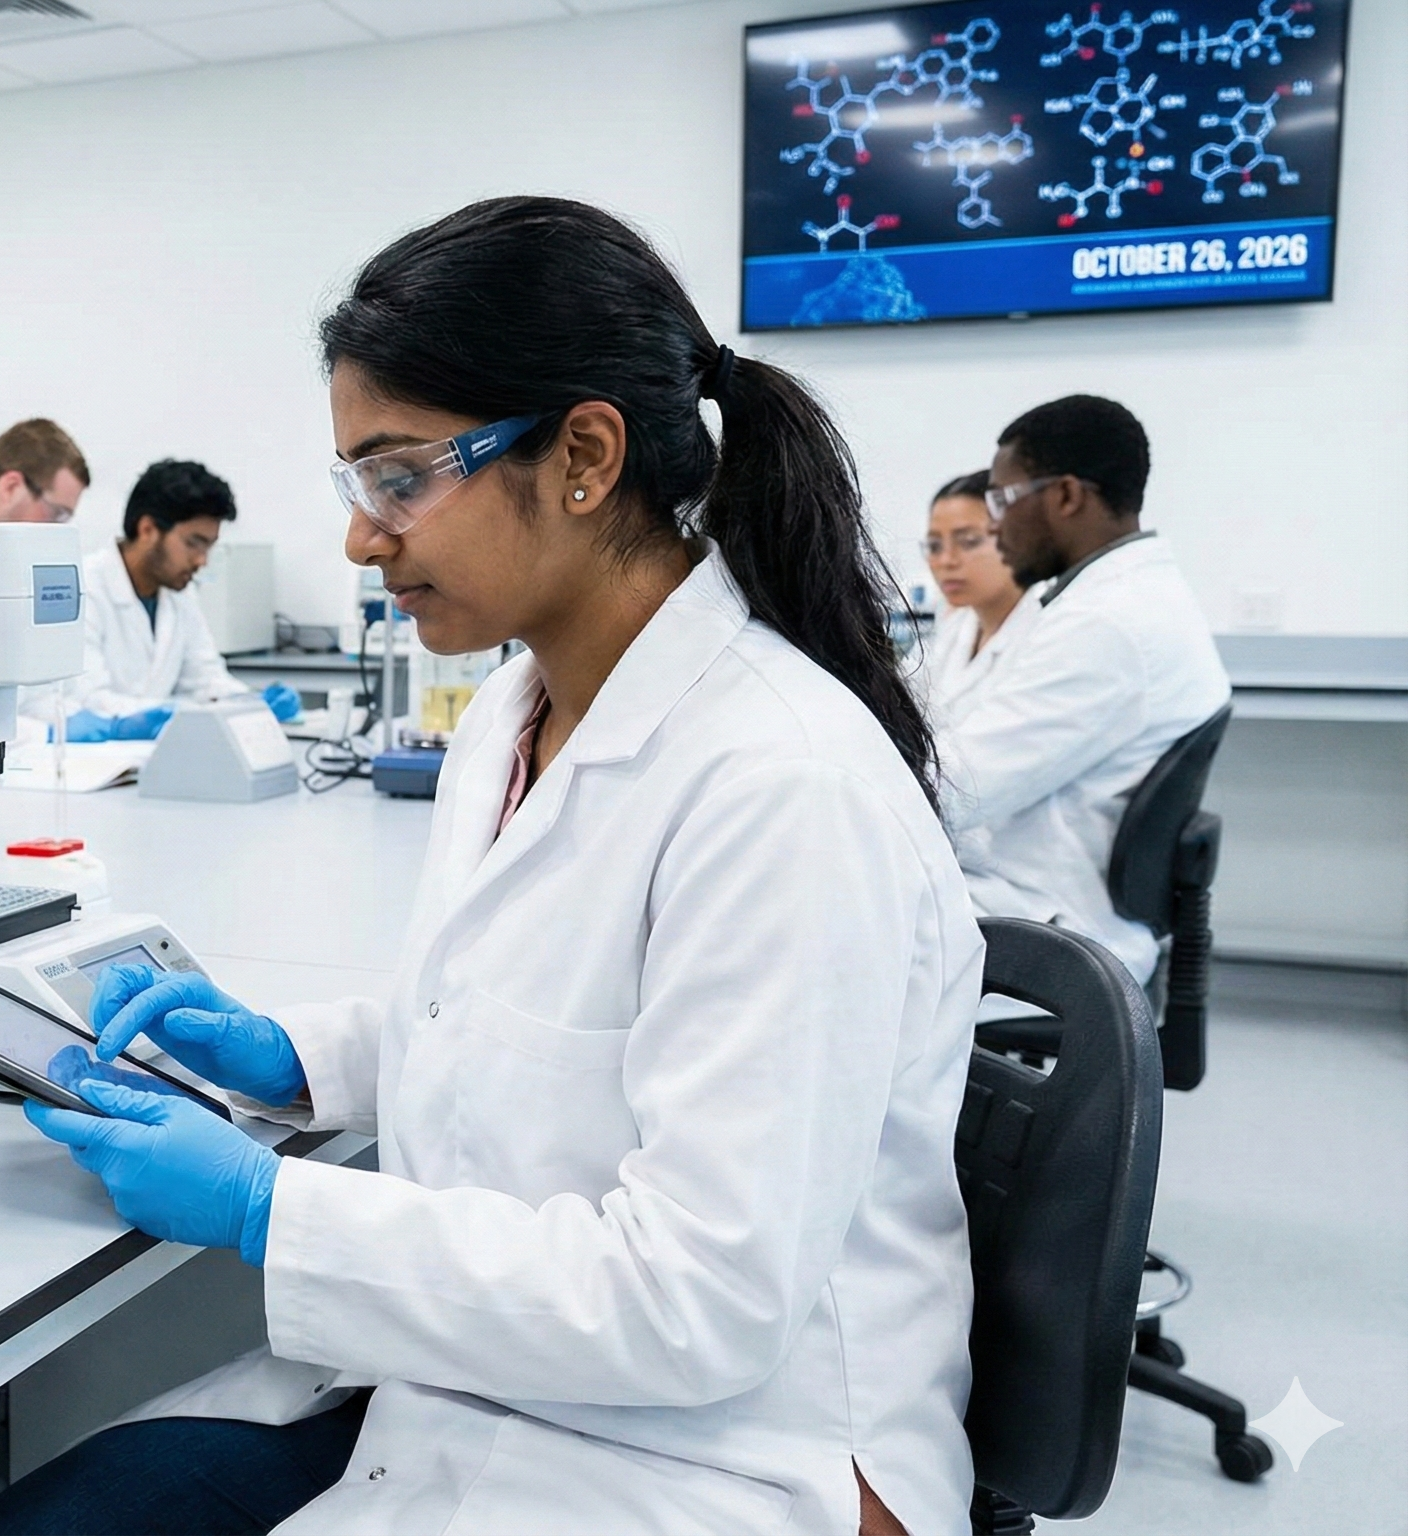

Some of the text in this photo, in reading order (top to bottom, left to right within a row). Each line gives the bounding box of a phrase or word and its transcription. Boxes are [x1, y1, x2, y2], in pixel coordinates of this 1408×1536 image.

[1072, 234, 1309, 279] OCTOBER 26, 2026
